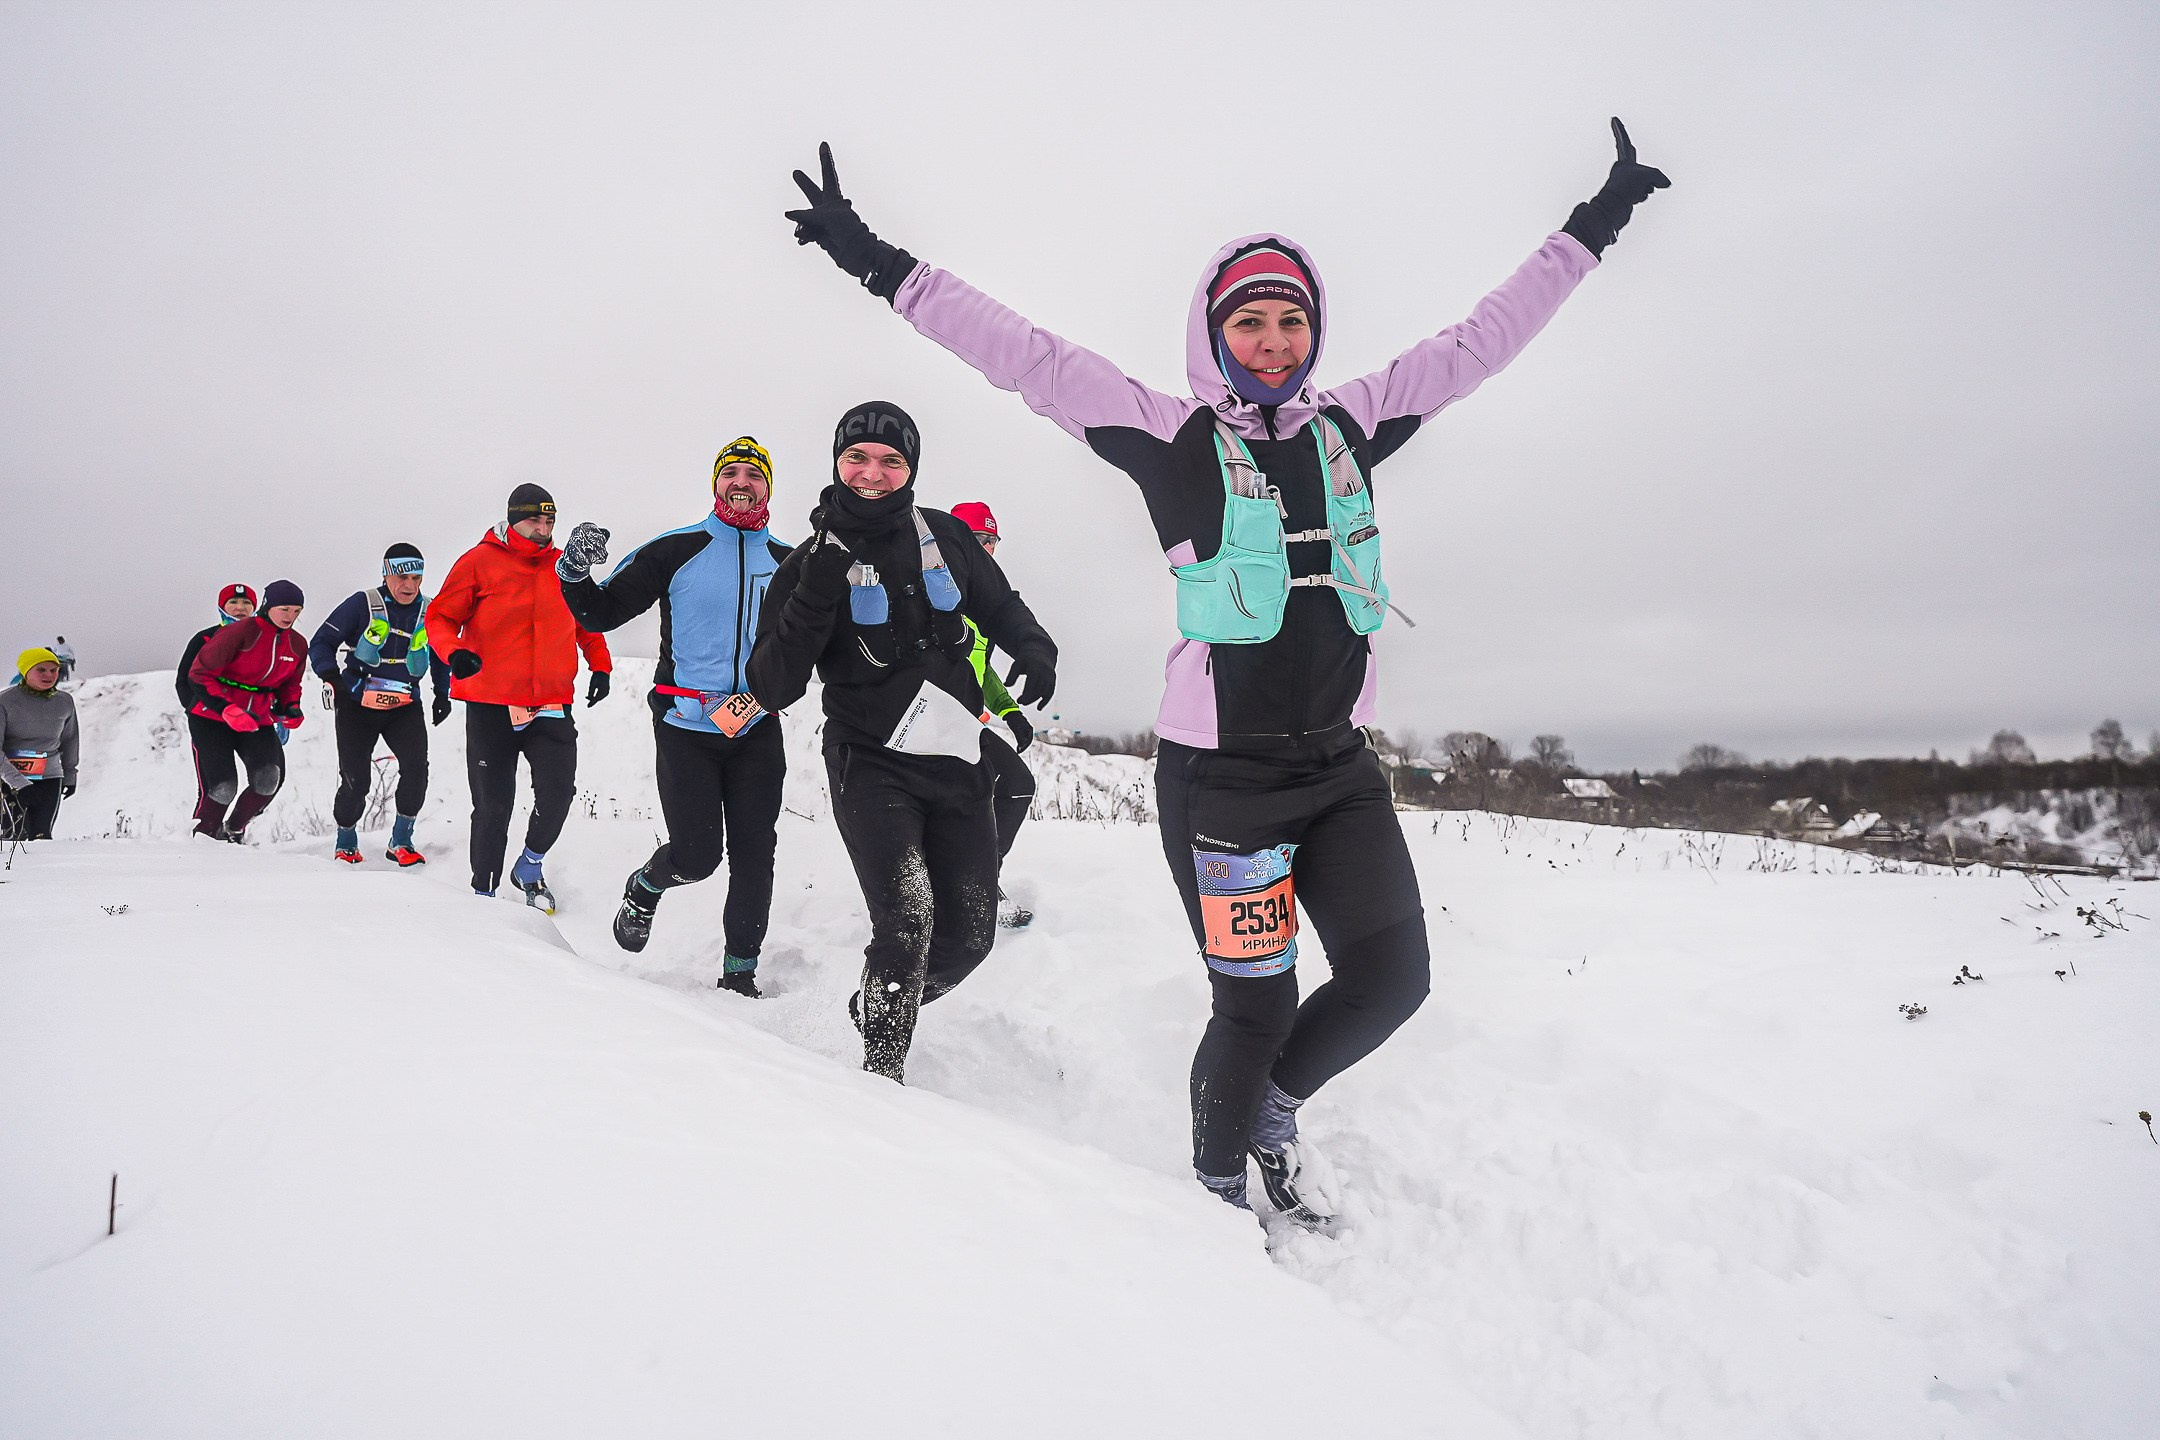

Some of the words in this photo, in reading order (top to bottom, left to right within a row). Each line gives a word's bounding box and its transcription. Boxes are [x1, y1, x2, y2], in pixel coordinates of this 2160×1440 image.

[1247, 286, 1300, 298] NORDSKI
[1204, 837, 1240, 850] NORDSKI
[1205, 860, 1230, 879] K20
[1230, 893, 1290, 935] 2534
[1242, 934, 1288, 950] ИРИНА
